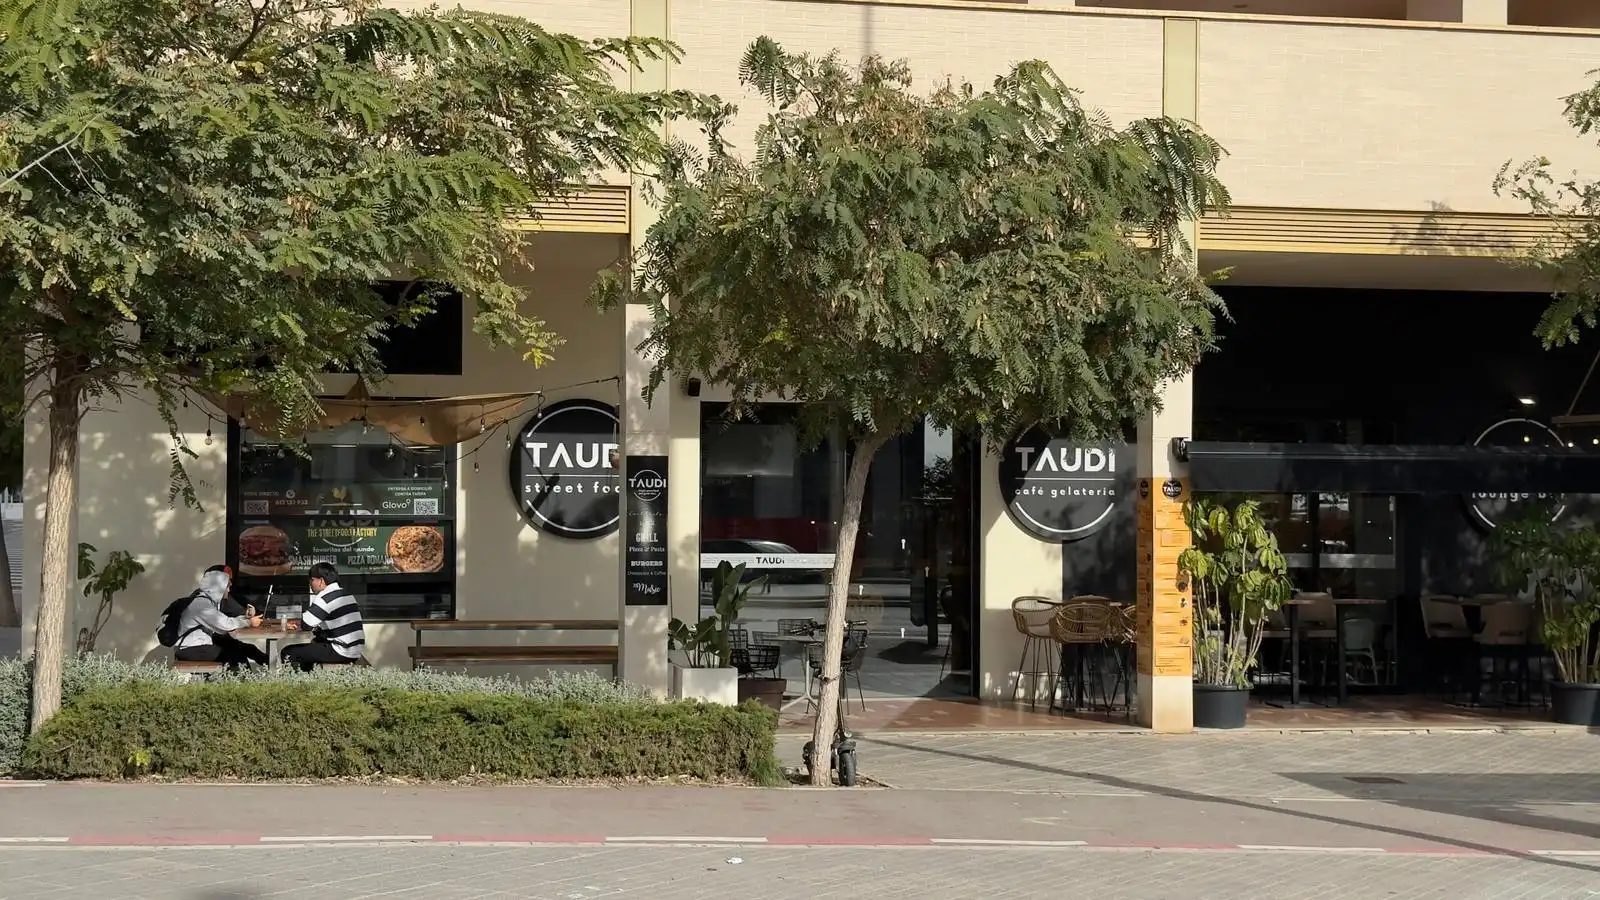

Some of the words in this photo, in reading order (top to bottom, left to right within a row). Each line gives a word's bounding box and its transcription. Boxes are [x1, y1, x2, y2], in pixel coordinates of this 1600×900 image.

[525, 442, 620, 469] TAUD
[1015, 446, 1116, 473] TAUDI
[525, 482, 583, 494] street
[593, 481, 620, 494] foo
[628, 478, 667, 488] TAUDI
[1015, 485, 1044, 496] café
[1050, 485, 1115, 498] gelateria
[1471, 492, 1529, 502] lounge
[382, 501, 408, 509] Glovo
[307, 528, 317, 538] THE
[635, 532, 659, 543] GRILL
[347, 555, 366, 565] PIZZA
